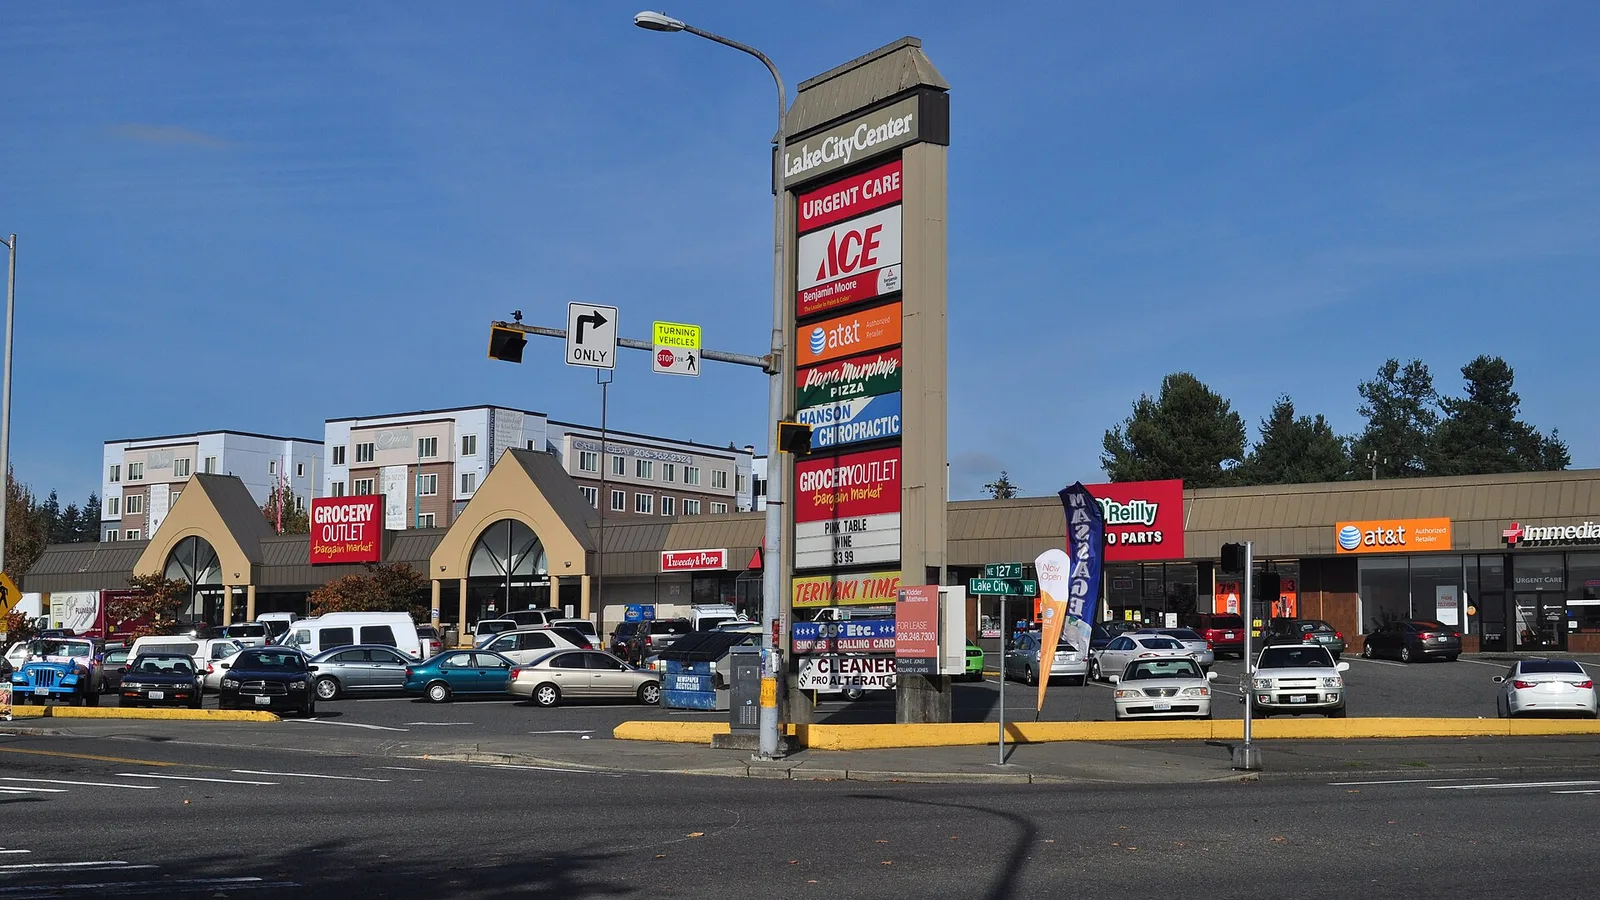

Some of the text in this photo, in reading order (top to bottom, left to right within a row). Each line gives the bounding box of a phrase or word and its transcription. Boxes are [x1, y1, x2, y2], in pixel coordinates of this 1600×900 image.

[784, 113, 912, 178] LakeCityCenter
[803, 172, 900, 219] URGENT CARE
[815, 224, 883, 281] ACE
[803, 280, 857, 302] Benjamin Moore
[659, 326, 696, 337] TURNING
[828, 316, 890, 349] at&t Authorized
[865, 329, 884, 339] Retailer
[659, 336, 695, 347] VEHICLES
[574, 348, 608, 362] ONLY
[657, 354, 674, 362] STOP
[803, 355, 898, 393] Papa Murphy's
[830, 382, 864, 398] PIZZA
[800, 404, 851, 425] HANSON
[819, 414, 900, 446] CHIROPRACTIC
[378, 431, 409, 448] Open
[601, 444, 631, 455] ODAY
[633, 448, 692, 465] 206-362-2324
[813, 487, 849, 511] bargain
[314, 503, 374, 524] GROCERY
[322, 523, 365, 542] OUTLET
[825, 519, 867, 534] PINK TABLE
[834, 535, 852, 548] WINE
[1121, 530, 1163, 544] PARTS
[1363, 525, 1447, 546] at&t Authorized
[313, 540, 373, 559] bargain market
[666, 554, 695, 568] Tweedy
[695, 555, 700, 565] &
[1042, 563, 1061, 572] Now
[987, 568, 994, 576] NE
[996, 565, 1011, 577] 127
[1041, 572, 1062, 581] Open
[796, 577, 900, 603] TERIYAKI TIME
[972, 579, 992, 591] Lake
[993, 580, 1009, 593] City
[1024, 585, 1034, 593] NE
[846, 624, 875, 637] Etc.
[897, 621, 927, 630] FOR LEASE
[897, 632, 936, 641] 206.248.7300
[796, 640, 826, 650] SMOKES
[837, 639, 870, 649] CALLING
[799, 658, 814, 687] BEST
[811, 675, 828, 685] PRO
[675, 682, 700, 690] RECYCLING
